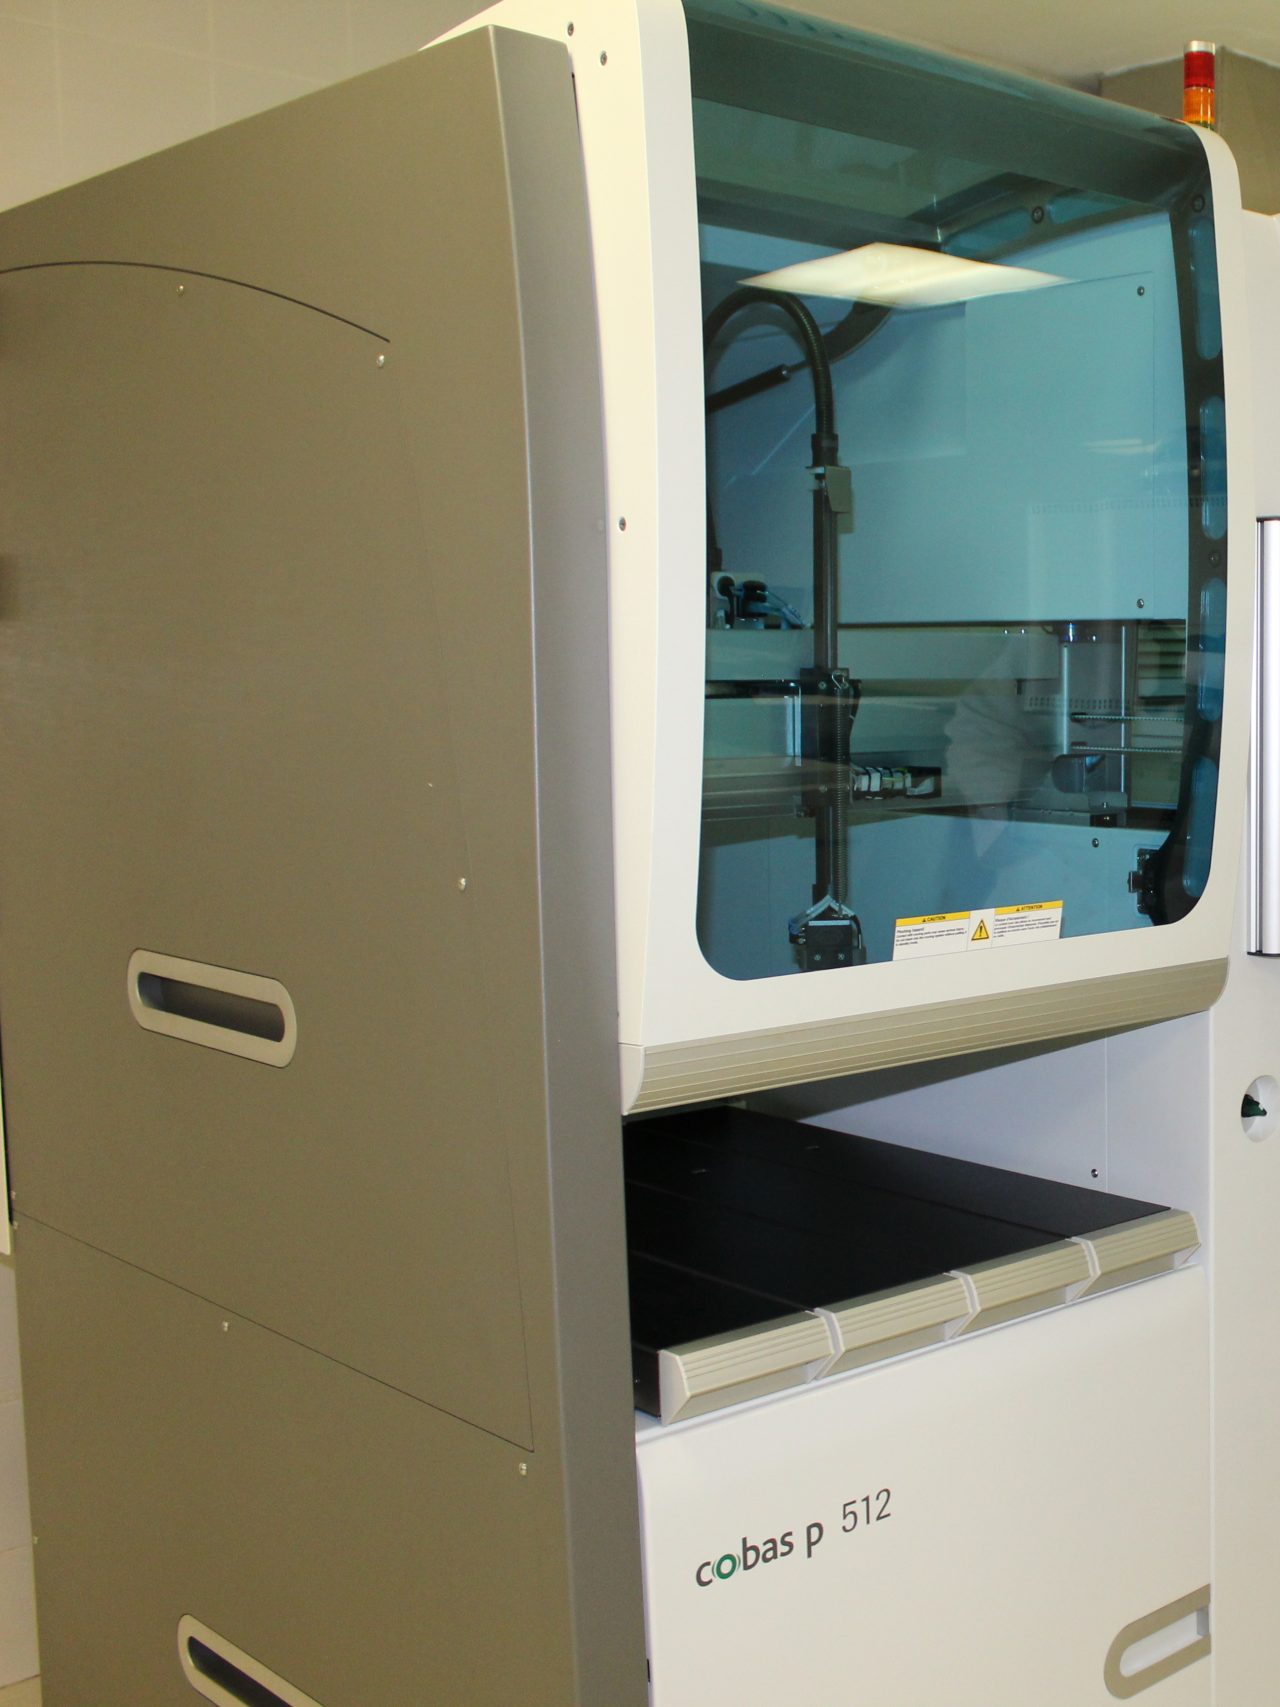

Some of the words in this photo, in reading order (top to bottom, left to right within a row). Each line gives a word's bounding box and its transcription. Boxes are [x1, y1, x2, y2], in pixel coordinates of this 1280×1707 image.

[927, 914, 946, 922] CAUTION
[695, 1531, 795, 1588] cobas
[806, 1522, 824, 1559] p
[842, 1488, 891, 1533] 512
